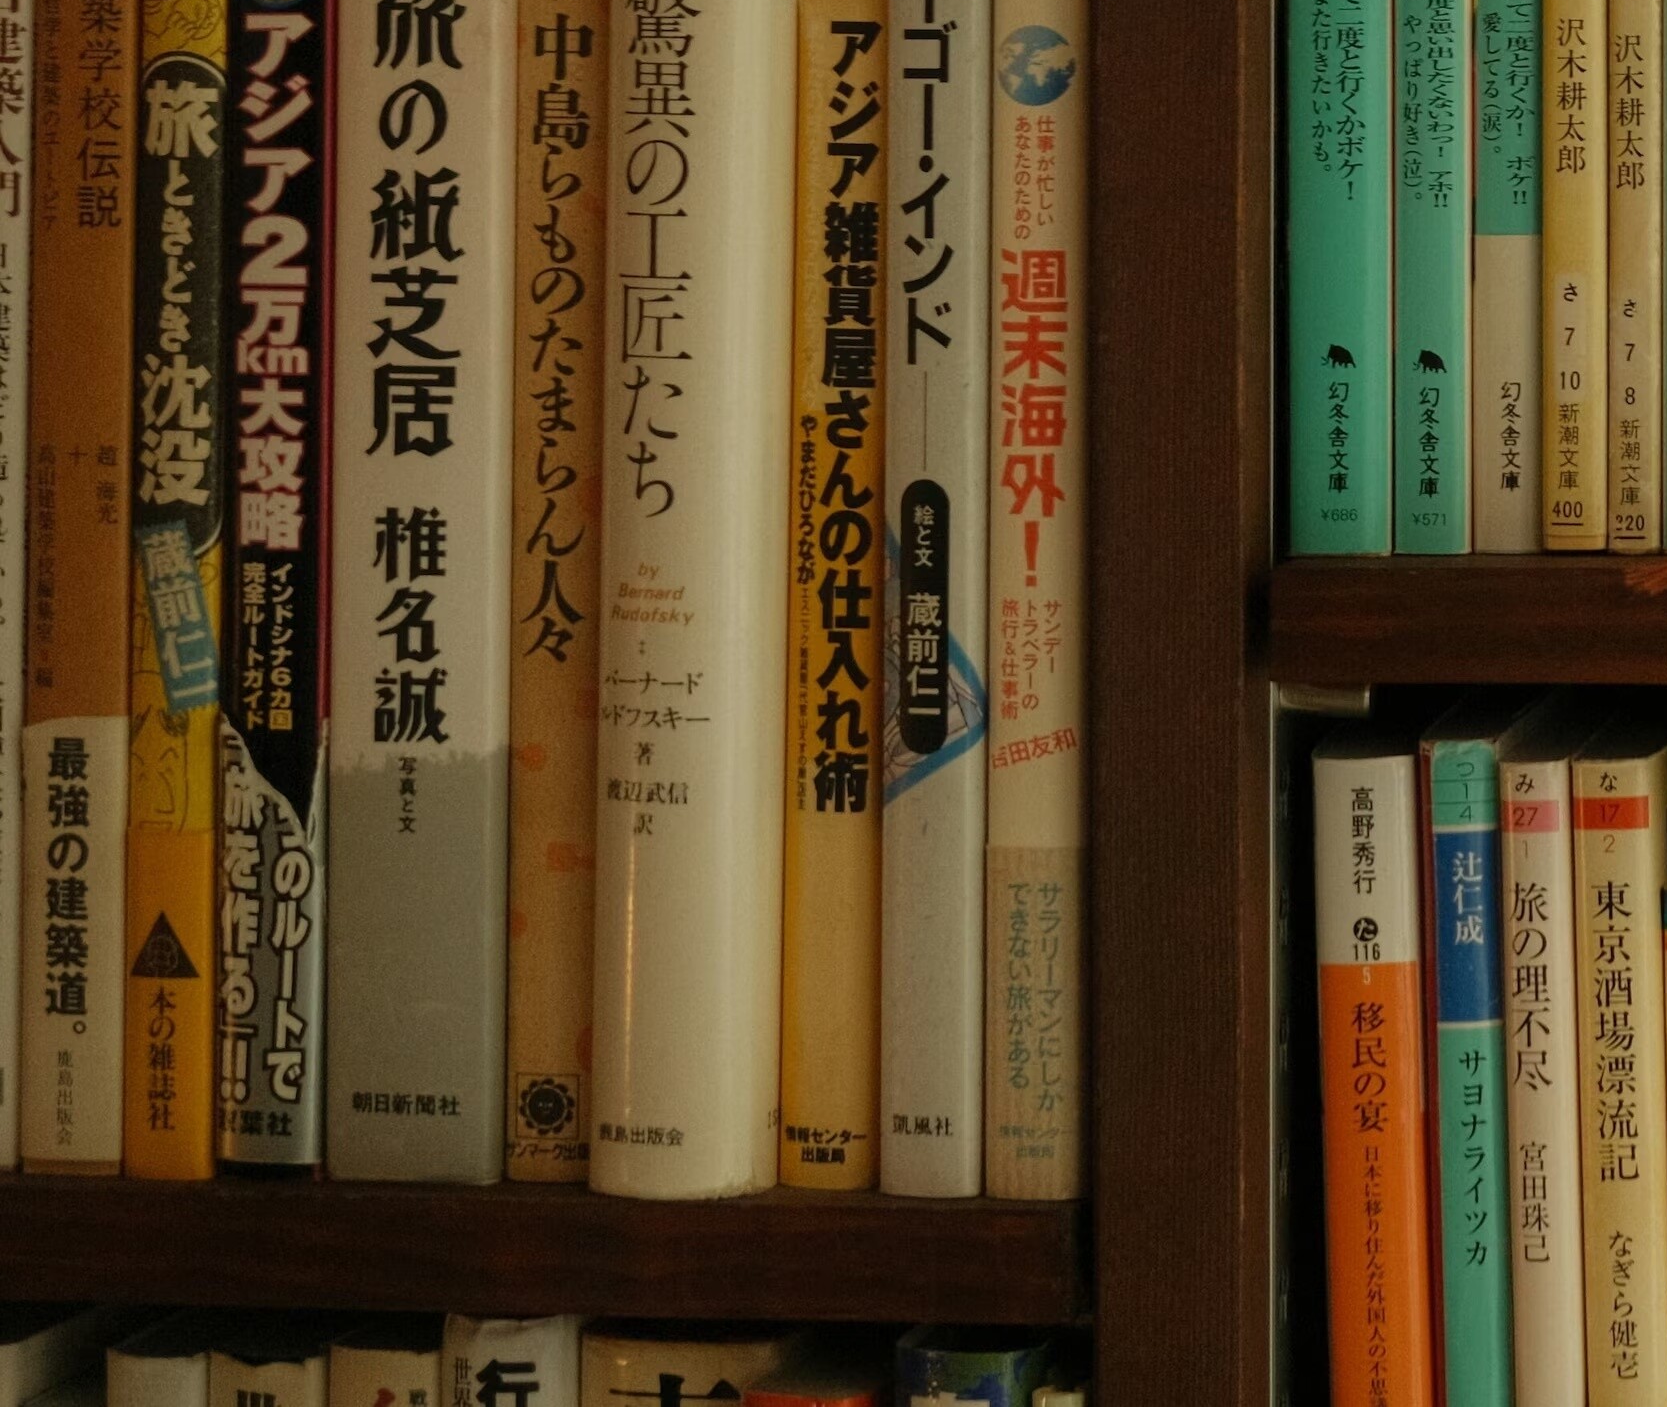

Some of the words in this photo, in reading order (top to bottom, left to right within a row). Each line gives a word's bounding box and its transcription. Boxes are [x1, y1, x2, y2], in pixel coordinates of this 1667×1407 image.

[1035, 114, 1058, 227] 仕事が忙しい
[1555, 17, 1589, 175] 沢木耕太郎
[1012, 114, 1033, 241] あなたのための
[138, 76, 223, 508] 旅ときどき沈没
[234, 9, 316, 553] アジア2万km大攻略
[520, 11, 596, 665] 中島らものたまらん人々
[812, 19, 883, 814] アジア雑貨屋さんの仕入れ術
[999, 248, 1070, 589] 週末海外！
[1327, 381, 1352, 494] 幻冬舎文庫
[912, 504, 936, 569] 絵と文
[1319, 506, 1359, 524] ¥686
[1551, 500, 1585, 520] 400
[241, 561, 267, 730] 完全ルートガイド
[372, 505, 451, 746] 椎名誠
[904, 591, 943, 719] 蔵前仁一
[396, 755, 418, 835] 写真と文
[1350, 786, 1376, 896] 高野秀行
[44, 735, 92, 1037] 最強の建築道。
[1452, 850, 1486, 947] 辻仁成
[146, 985, 177, 1133] 本の雑誌社
[1006, 881, 1034, 1091] できない旅がある
[1034, 881, 1064, 1115] サラリーマンにしか
[1510, 882, 1553, 1093] 旅の理不尽
[1591, 881, 1640, 1184] 東京酒場漂流記
[351, 1090, 463, 1117] 朝日新聞社
[893, 1113, 955, 1139] 凱風社
[1350, 1002, 1388, 1135] 移民の宴
[1458, 1050, 1490, 1267] サヨナライツカ
